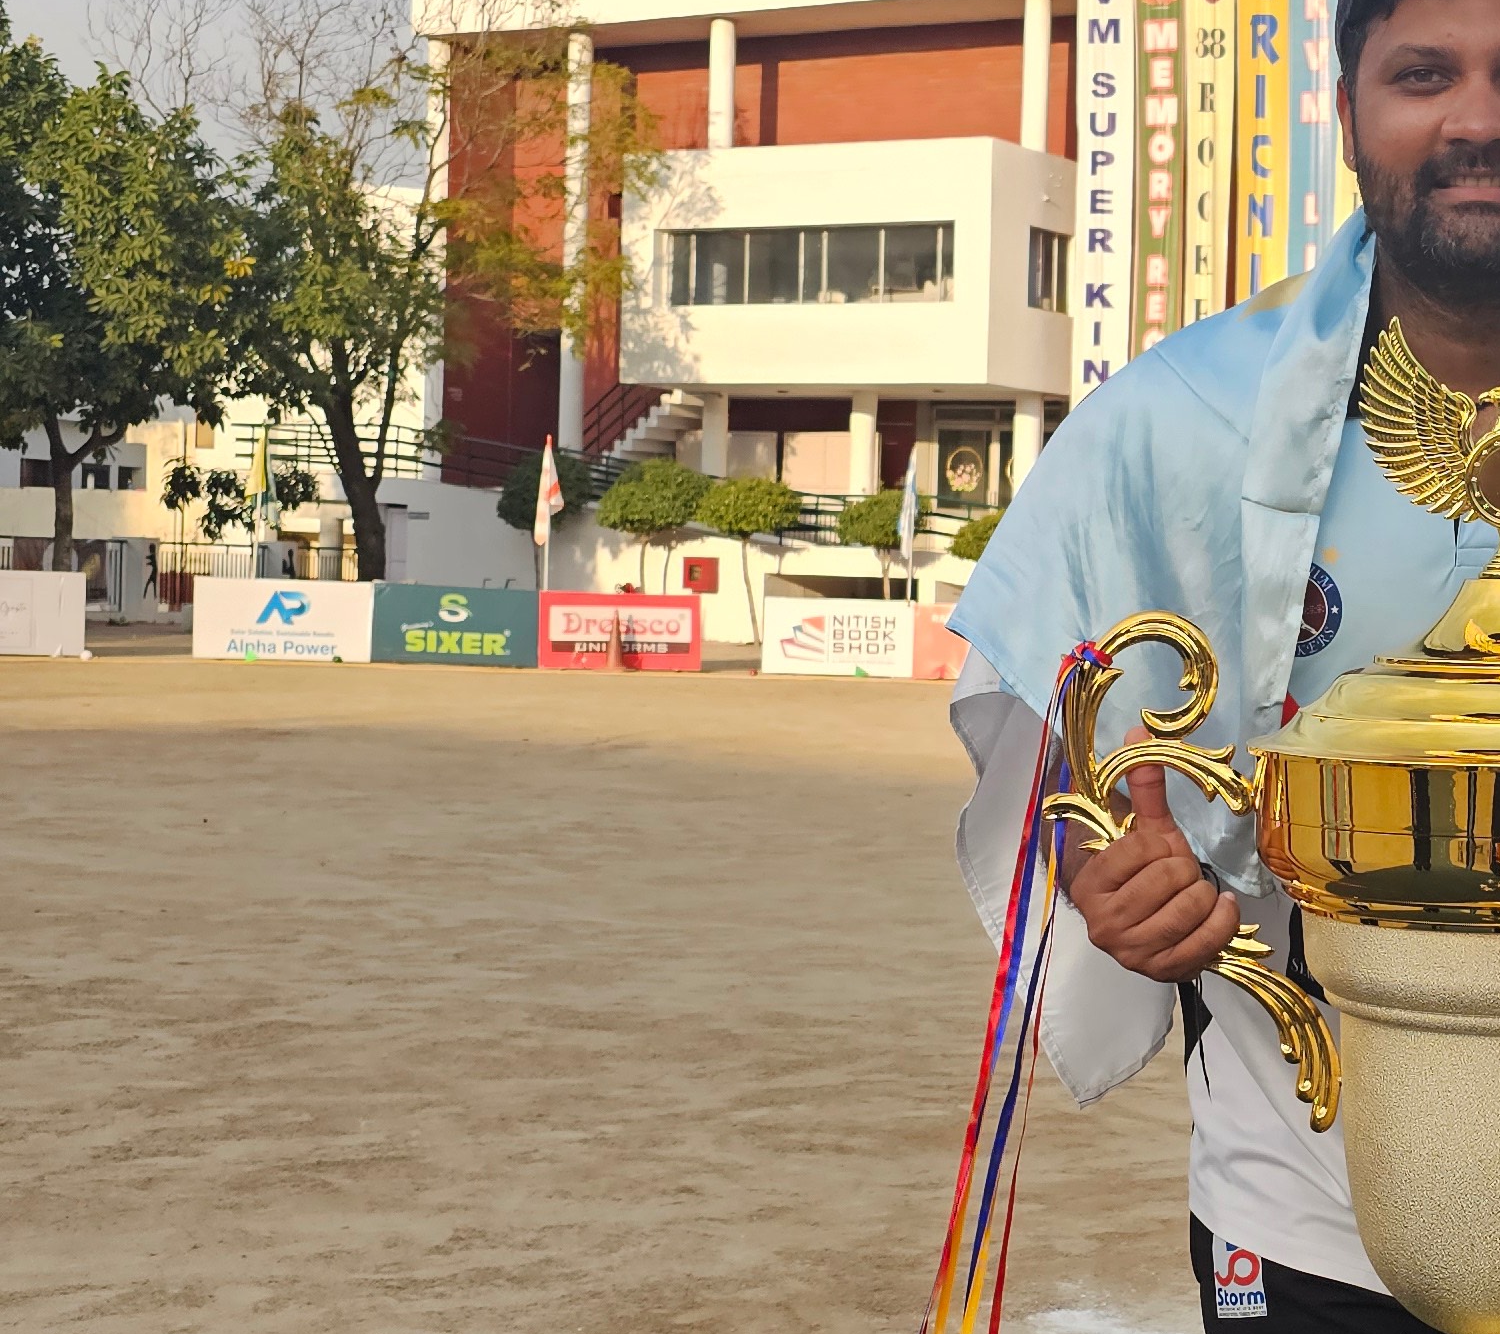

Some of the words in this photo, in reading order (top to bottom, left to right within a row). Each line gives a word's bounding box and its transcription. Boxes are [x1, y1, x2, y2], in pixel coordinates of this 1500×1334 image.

[1144, 19, 1178, 239] MEMORY
[1088, 72, 1117, 253] SUPER
[833, 615, 895, 628] NITISH
[405, 629, 507, 655] SIXER
[833, 630, 894, 641] BOOK
[227, 639, 276, 657] Alpha
[284, 641, 337, 655] Power
[574, 641, 668, 653] UNIORMS
[833, 643, 895, 654] SHOP
[1218, 1288, 1264, 1306] Storm
